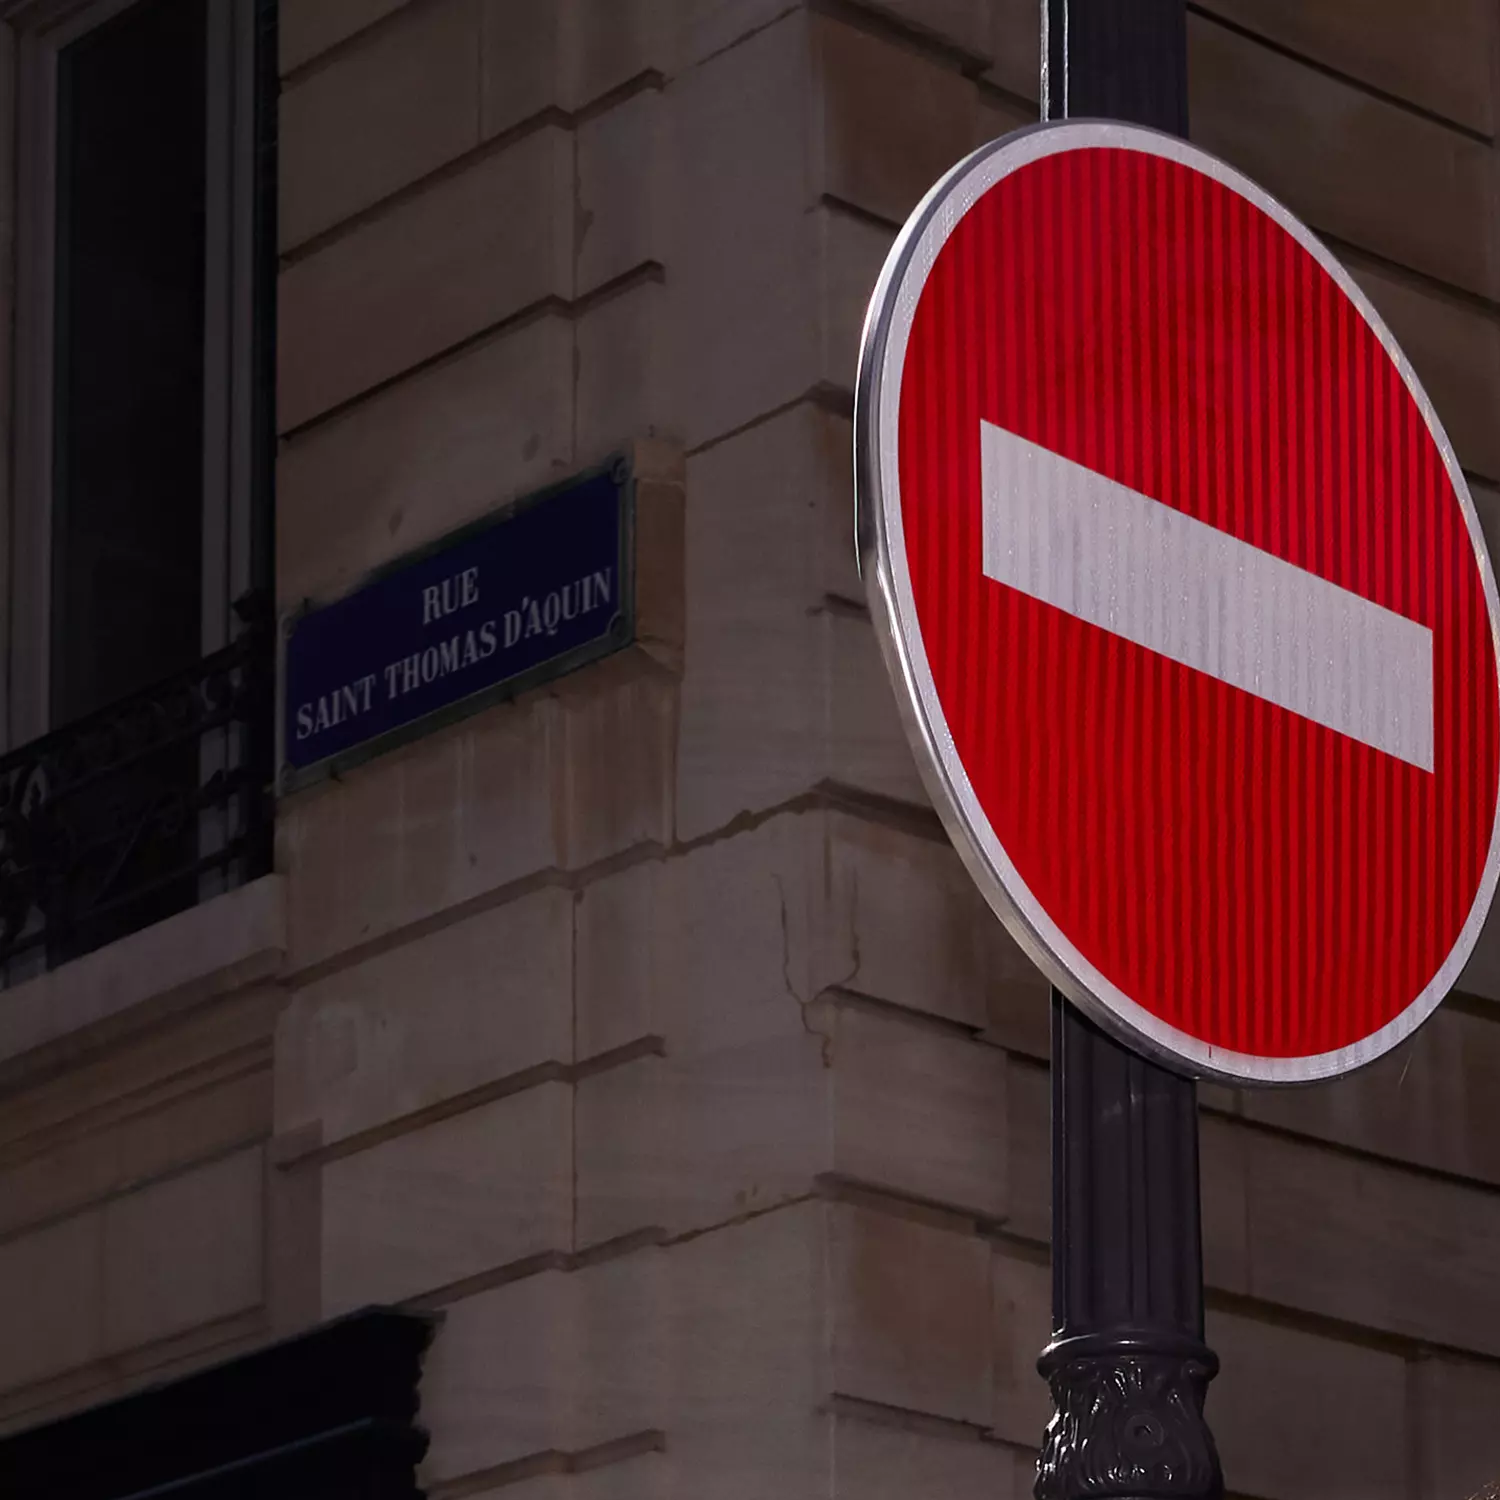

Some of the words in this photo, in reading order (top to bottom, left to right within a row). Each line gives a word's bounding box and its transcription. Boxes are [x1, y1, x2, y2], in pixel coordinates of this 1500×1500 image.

[422, 567, 479, 624] RUE
[296, 674, 376, 740] SAINT
[385, 620, 497, 700] THOMAS
[503, 567, 612, 649] D'AQUIN
